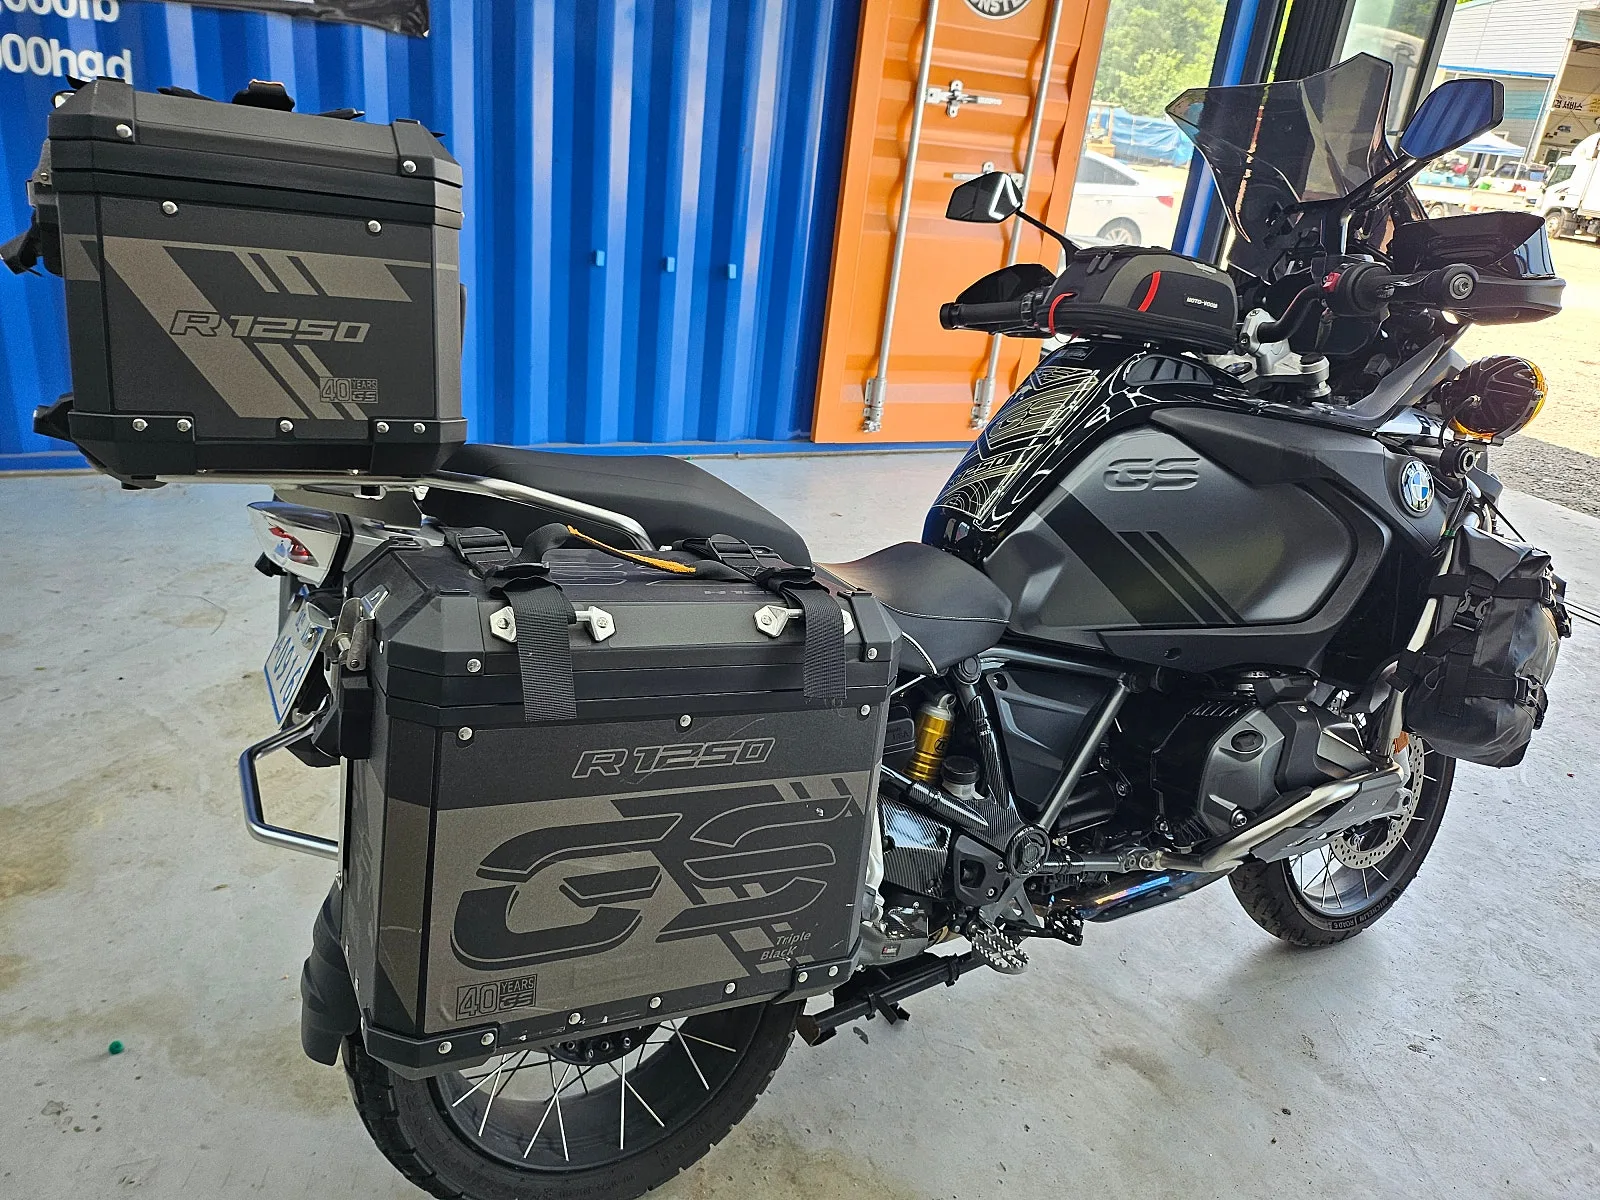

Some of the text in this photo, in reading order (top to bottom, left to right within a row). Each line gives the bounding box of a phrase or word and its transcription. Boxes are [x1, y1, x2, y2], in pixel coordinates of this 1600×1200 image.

[321, 378, 377, 401] 40 YEARS
[1103, 457, 1200, 491] GS
[450, 795, 852, 970] GS
[1359, 898, 1389, 922] MICHELIN
[776, 931, 811, 945] Triple
[458, 978, 534, 1016] 40 YEARS
[500, 991, 533, 1010] GS
